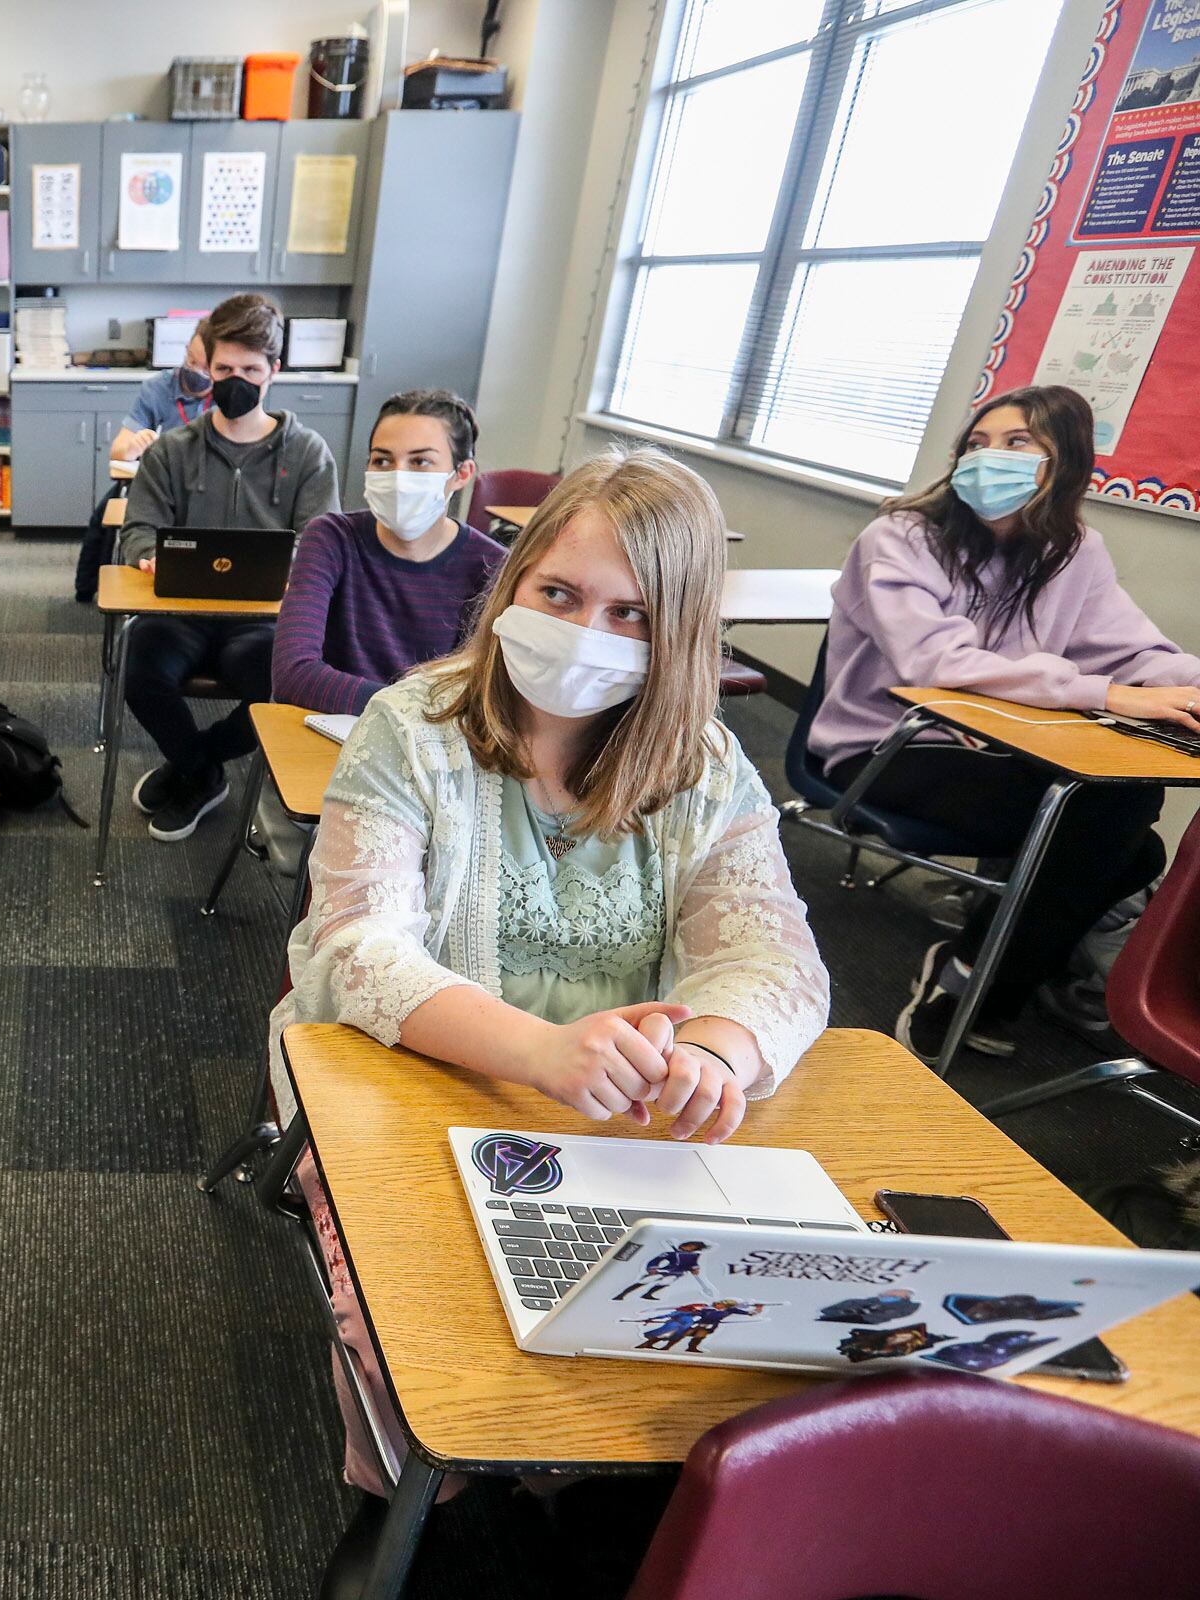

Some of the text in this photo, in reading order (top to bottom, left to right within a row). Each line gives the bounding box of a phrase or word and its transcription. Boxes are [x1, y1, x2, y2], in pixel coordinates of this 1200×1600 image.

[1164, 0, 1184, 12] The
[1152, 3, 1200, 34] Legisl
[1107, 149, 1165, 166] The Senate
[1087, 258, 1175, 271] AMENDING THE
[1083, 272, 1168, 284] CONSTITUTION
[214, 558, 232, 573] hp
[740, 1250, 930, 1273] STRENGTH
